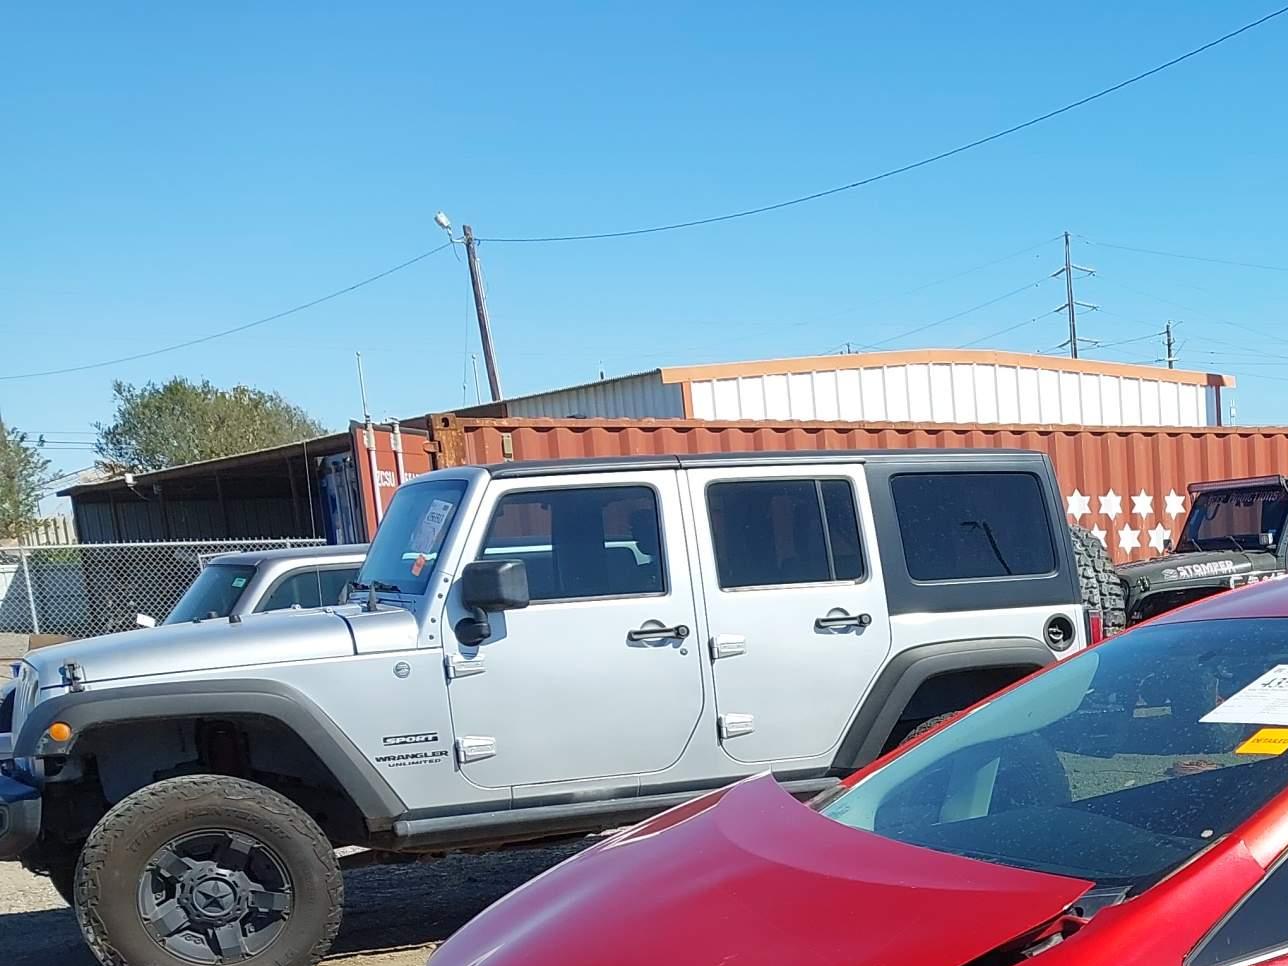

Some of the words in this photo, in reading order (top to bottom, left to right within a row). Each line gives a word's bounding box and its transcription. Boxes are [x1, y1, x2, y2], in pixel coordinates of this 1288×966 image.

[1176, 560, 1235, 579] STOMPER
[384, 733, 438, 746] SPORT
[375, 750, 449, 763] WRANGLER
[388, 758, 442, 768] UNLIMITED
